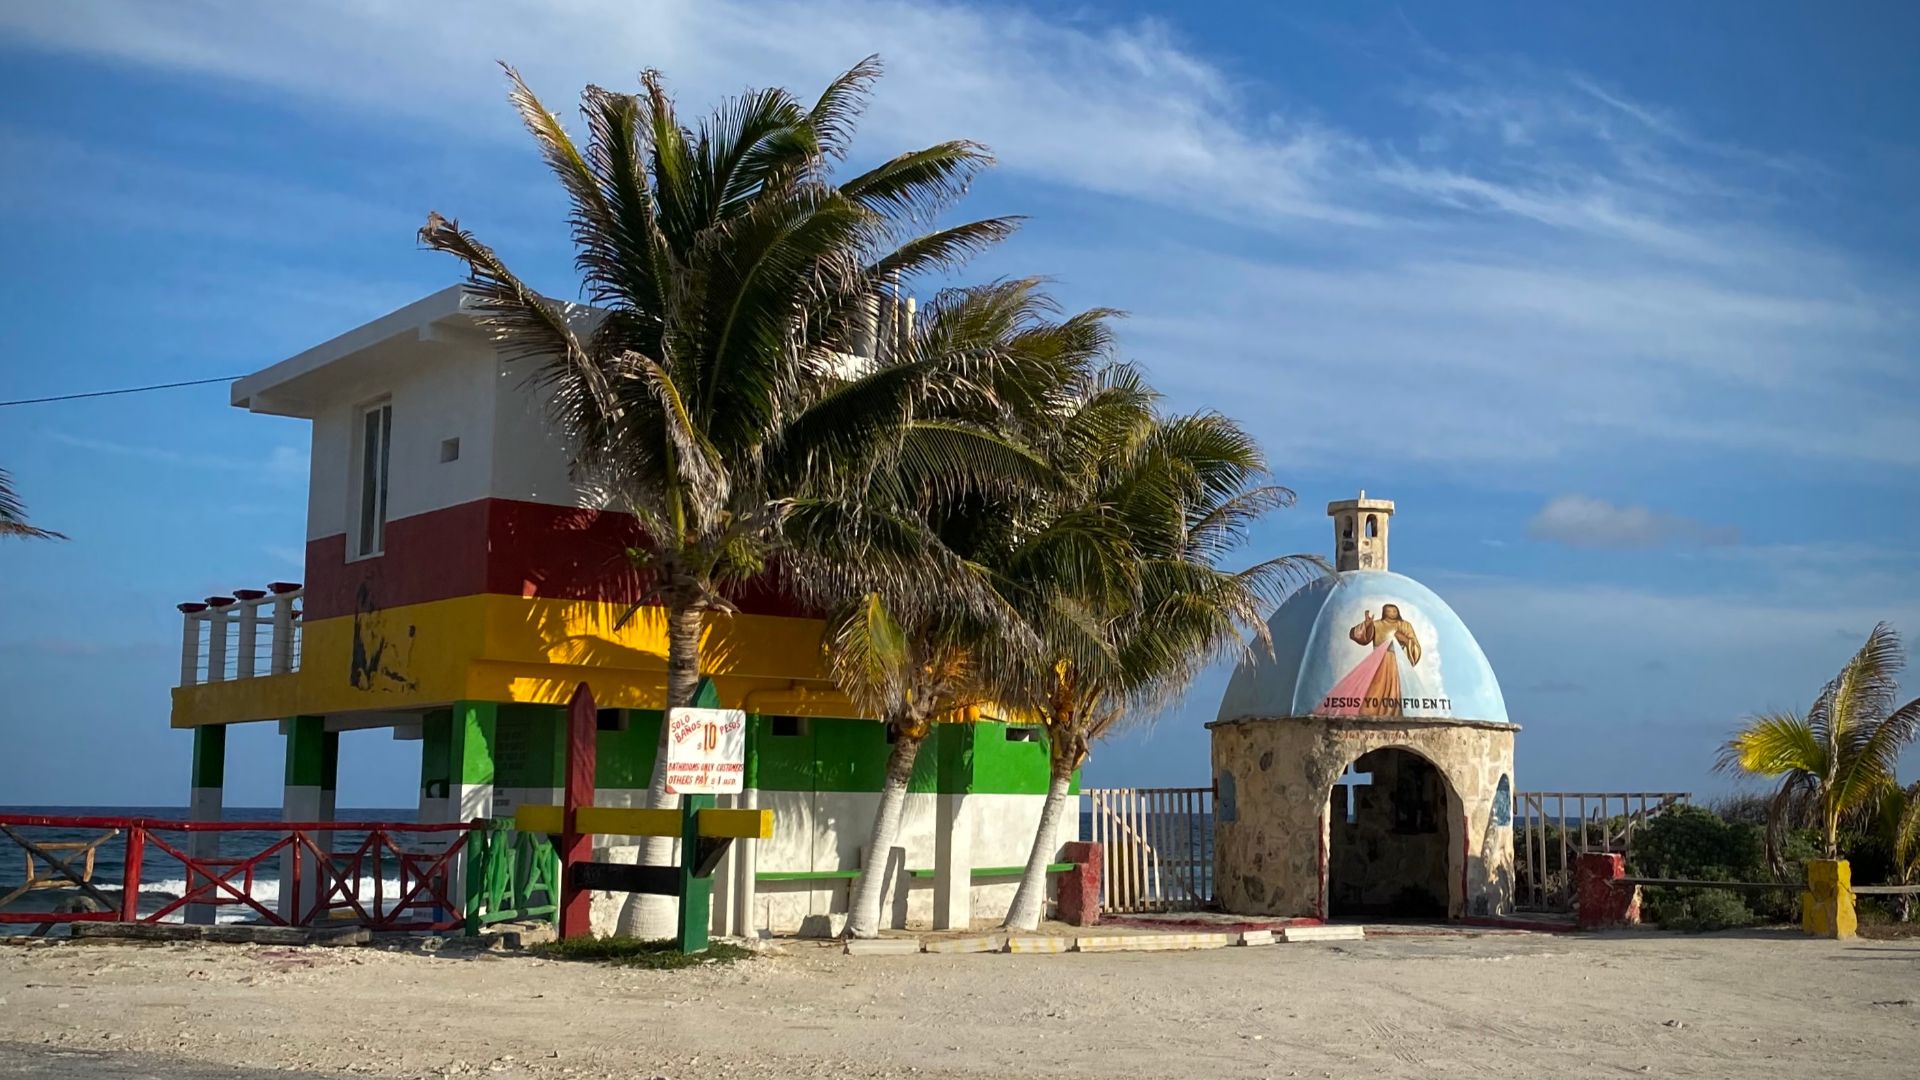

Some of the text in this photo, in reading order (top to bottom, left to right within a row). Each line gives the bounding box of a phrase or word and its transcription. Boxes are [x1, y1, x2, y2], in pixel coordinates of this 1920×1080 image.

[1324, 698, 1451, 710] JESUS YO CONFIO EN TI
[671, 715, 690, 733] SOLO
[719, 720, 741, 735] PESOS
[674, 720, 701, 743] BAÑOS
[668, 763, 744, 772] BATHROOMS ONLY CUSTOMERS
[668, 775, 692, 785] OTHERS
[695, 775, 708, 785] PAY
